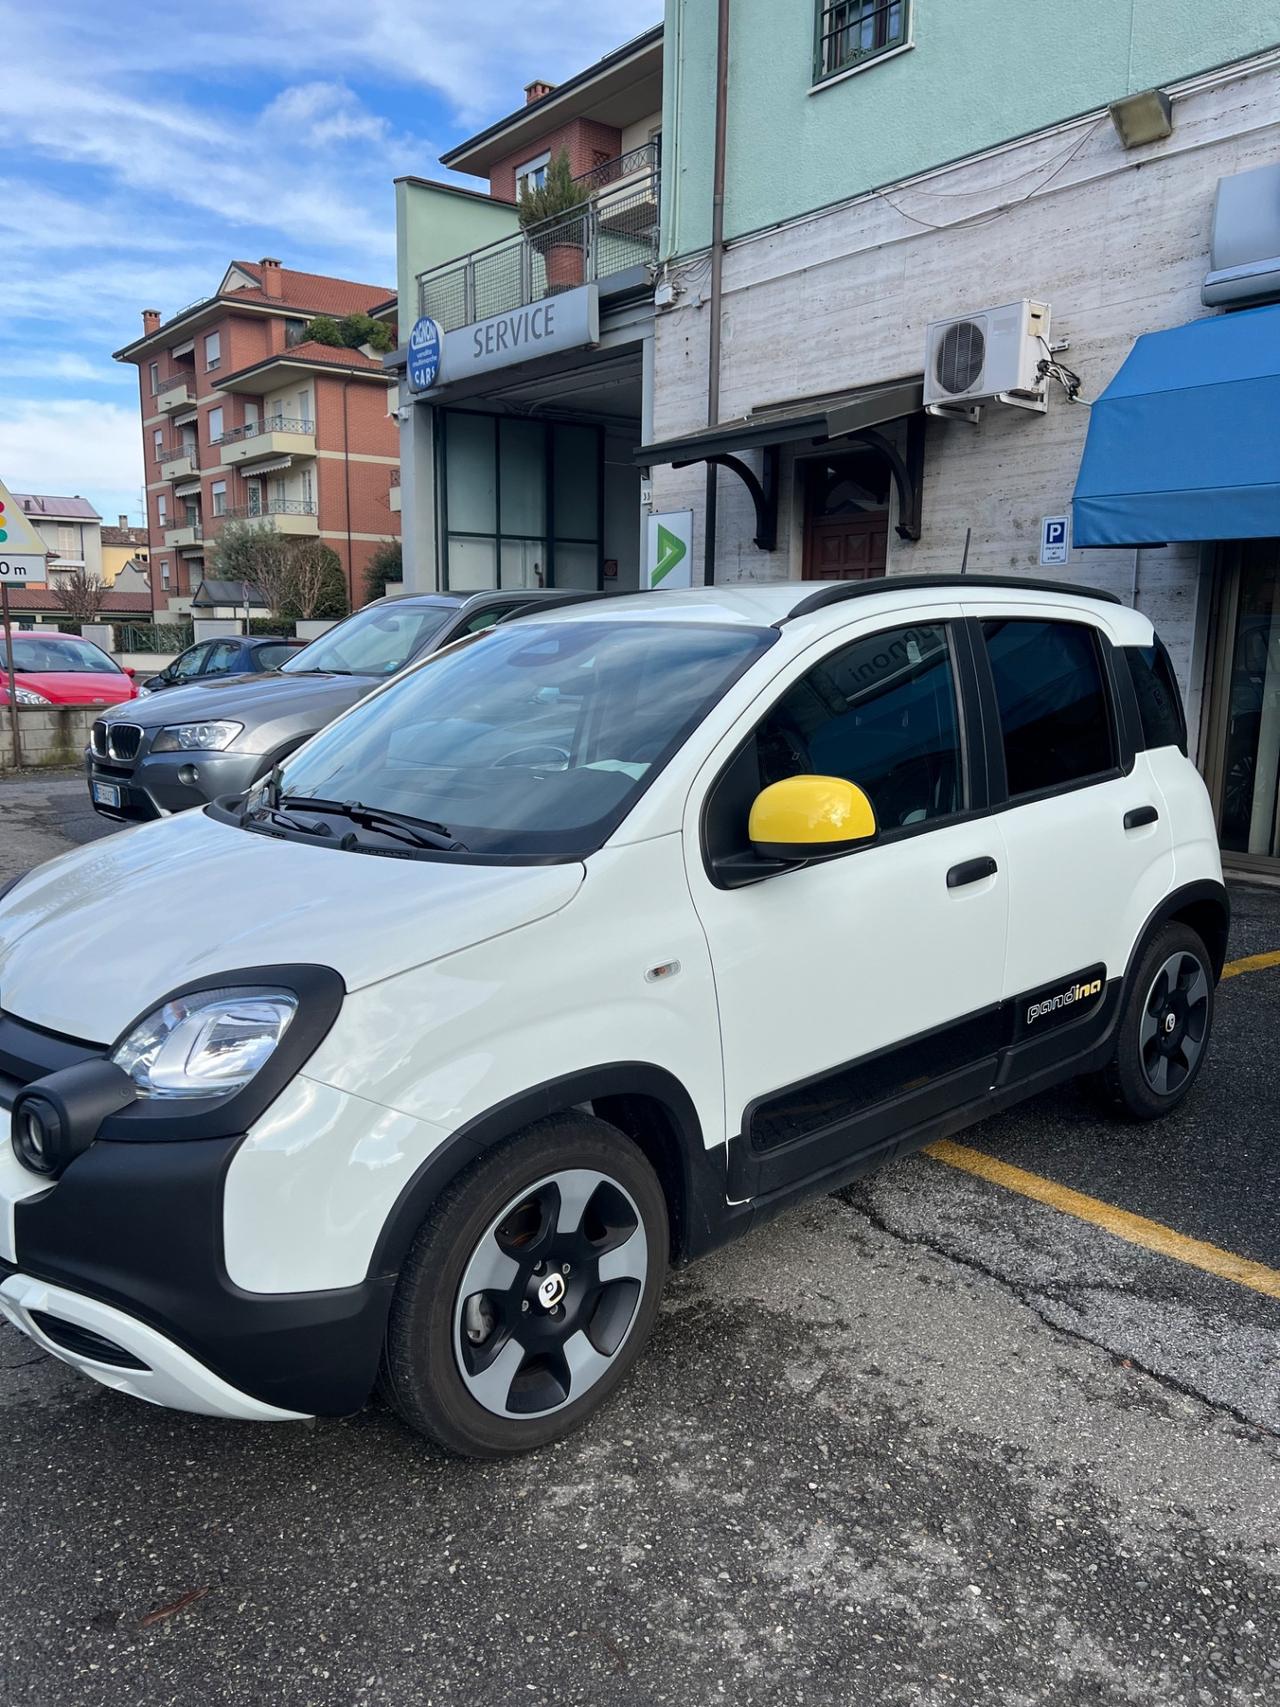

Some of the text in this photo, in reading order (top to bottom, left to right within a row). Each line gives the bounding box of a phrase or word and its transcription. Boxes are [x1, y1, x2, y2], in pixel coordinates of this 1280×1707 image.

[473, 304, 555, 358] SERVICE
[414, 367, 435, 386] CARS
[1049, 524, 1062, 542] P
[14, 566, 27, 575] m
[1027, 979, 1101, 1024] pandina
